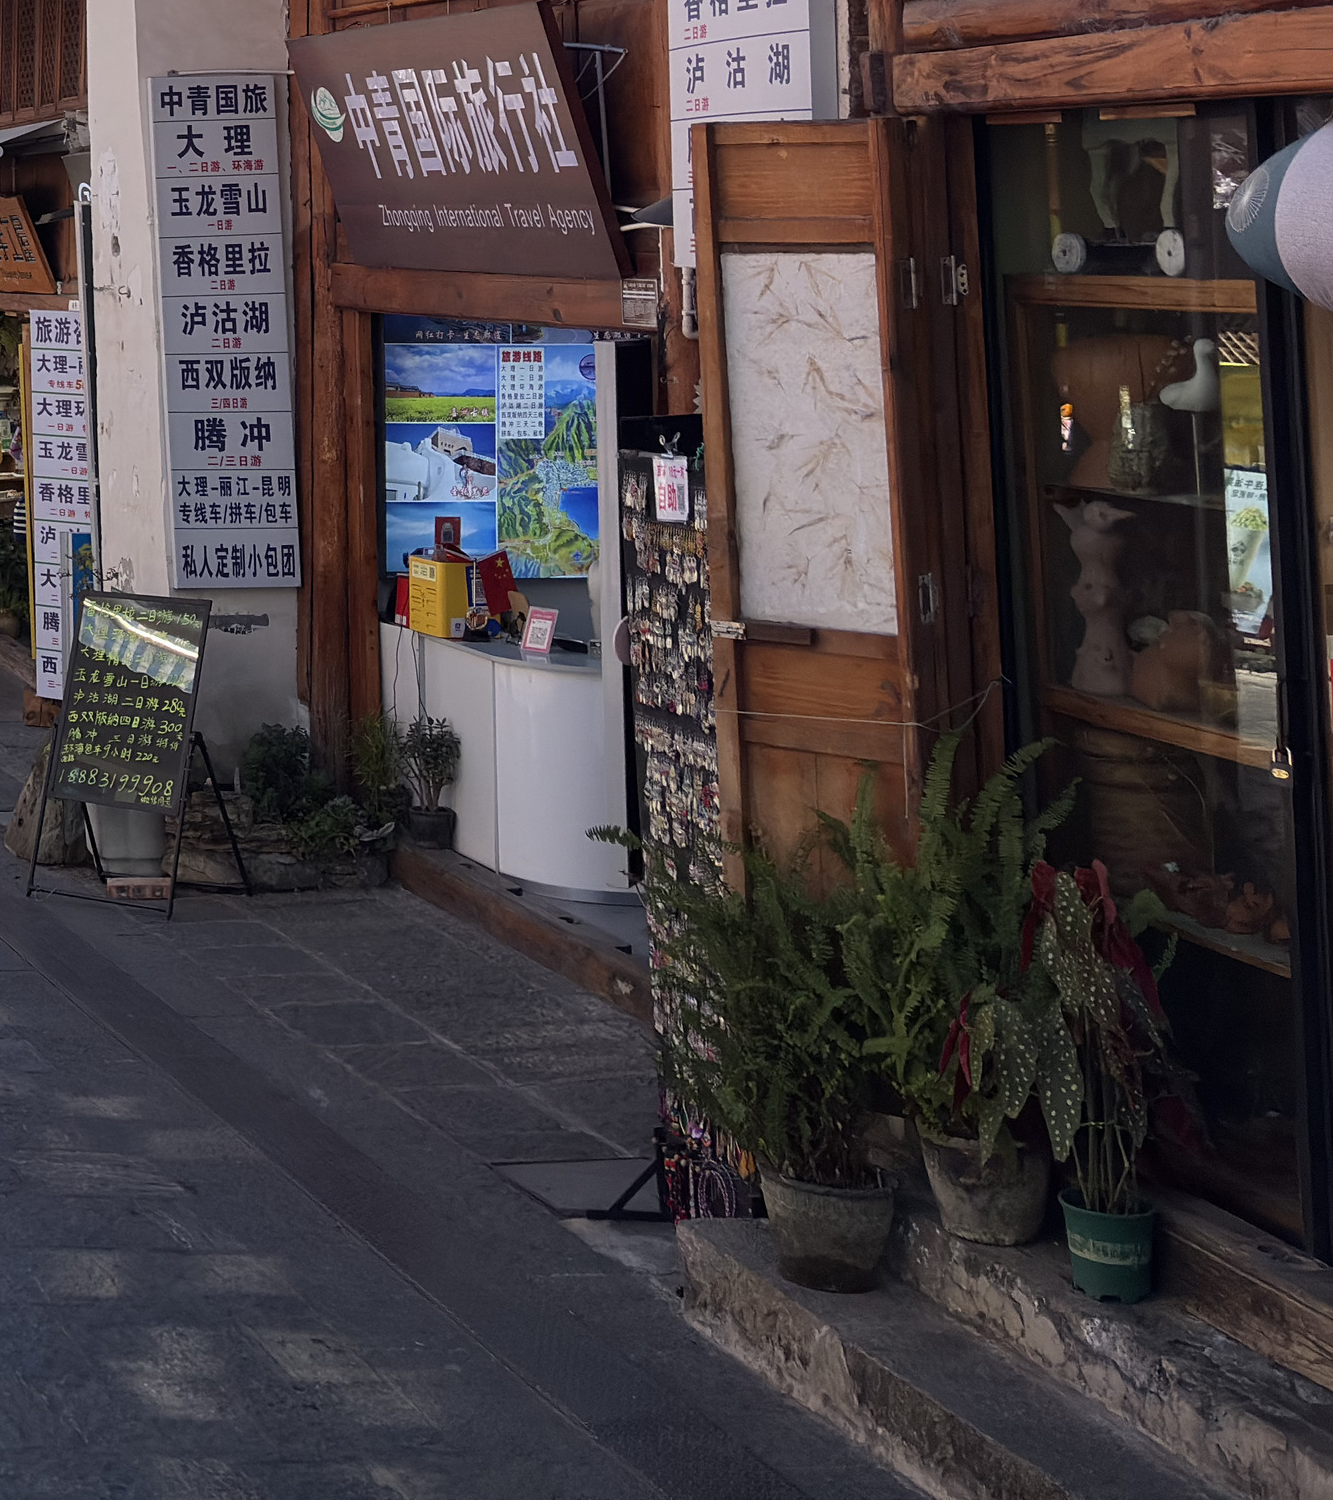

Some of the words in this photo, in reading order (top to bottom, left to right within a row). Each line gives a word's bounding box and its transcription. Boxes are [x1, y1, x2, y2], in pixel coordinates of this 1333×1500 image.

[684, 24, 708, 41] 二日游
[685, 42, 791, 94] 泸沽湖
[160, 84, 267, 117] 中青国旅
[686, 97, 709, 112] 二日游
[344, 53, 579, 180] 中青国际旅行社
[176, 124, 253, 159] 大理
[167, 159, 264, 173] 一、二日游、环海游
[170, 182, 267, 217] 玉龙雪山
[207, 220, 233, 231] 一日游
[378, 204, 434, 233] Zhongqing
[434, 204, 504, 228] International
[504, 203, 545, 228] Travel
[549, 203, 595, 236] Agency
[172, 241, 271, 277] 香格里拉
[210, 279, 236, 290] 二日游
[181, 301, 270, 335] 泸沽湖
[211, 337, 242, 349] 二日游
[501, 350, 542, 362] 旅游线路
[179, 356, 277, 391] 西双版纳
[501, 374, 543, 382] 大理二日游
[211, 397, 248, 409] 三/四日游
[501, 392, 543, 400] 香格里拉二日游
[47, 422, 74, 432] 一日游
[193, 417, 271, 452] 腾冲
[208, 455, 262, 467] 二/三日游
[657, 482, 678, 512] 自助
[50, 507, 76, 518] 二日游
[179, 502, 293, 525] 专线车/拼车/包车
[182, 543, 296, 579] 私人定制小包团
[73, 690, 159, 712] 泸沽湖二日游
[68, 710, 156, 730] 西双版纳四日游
[58, 767, 174, 797] 18883199908
